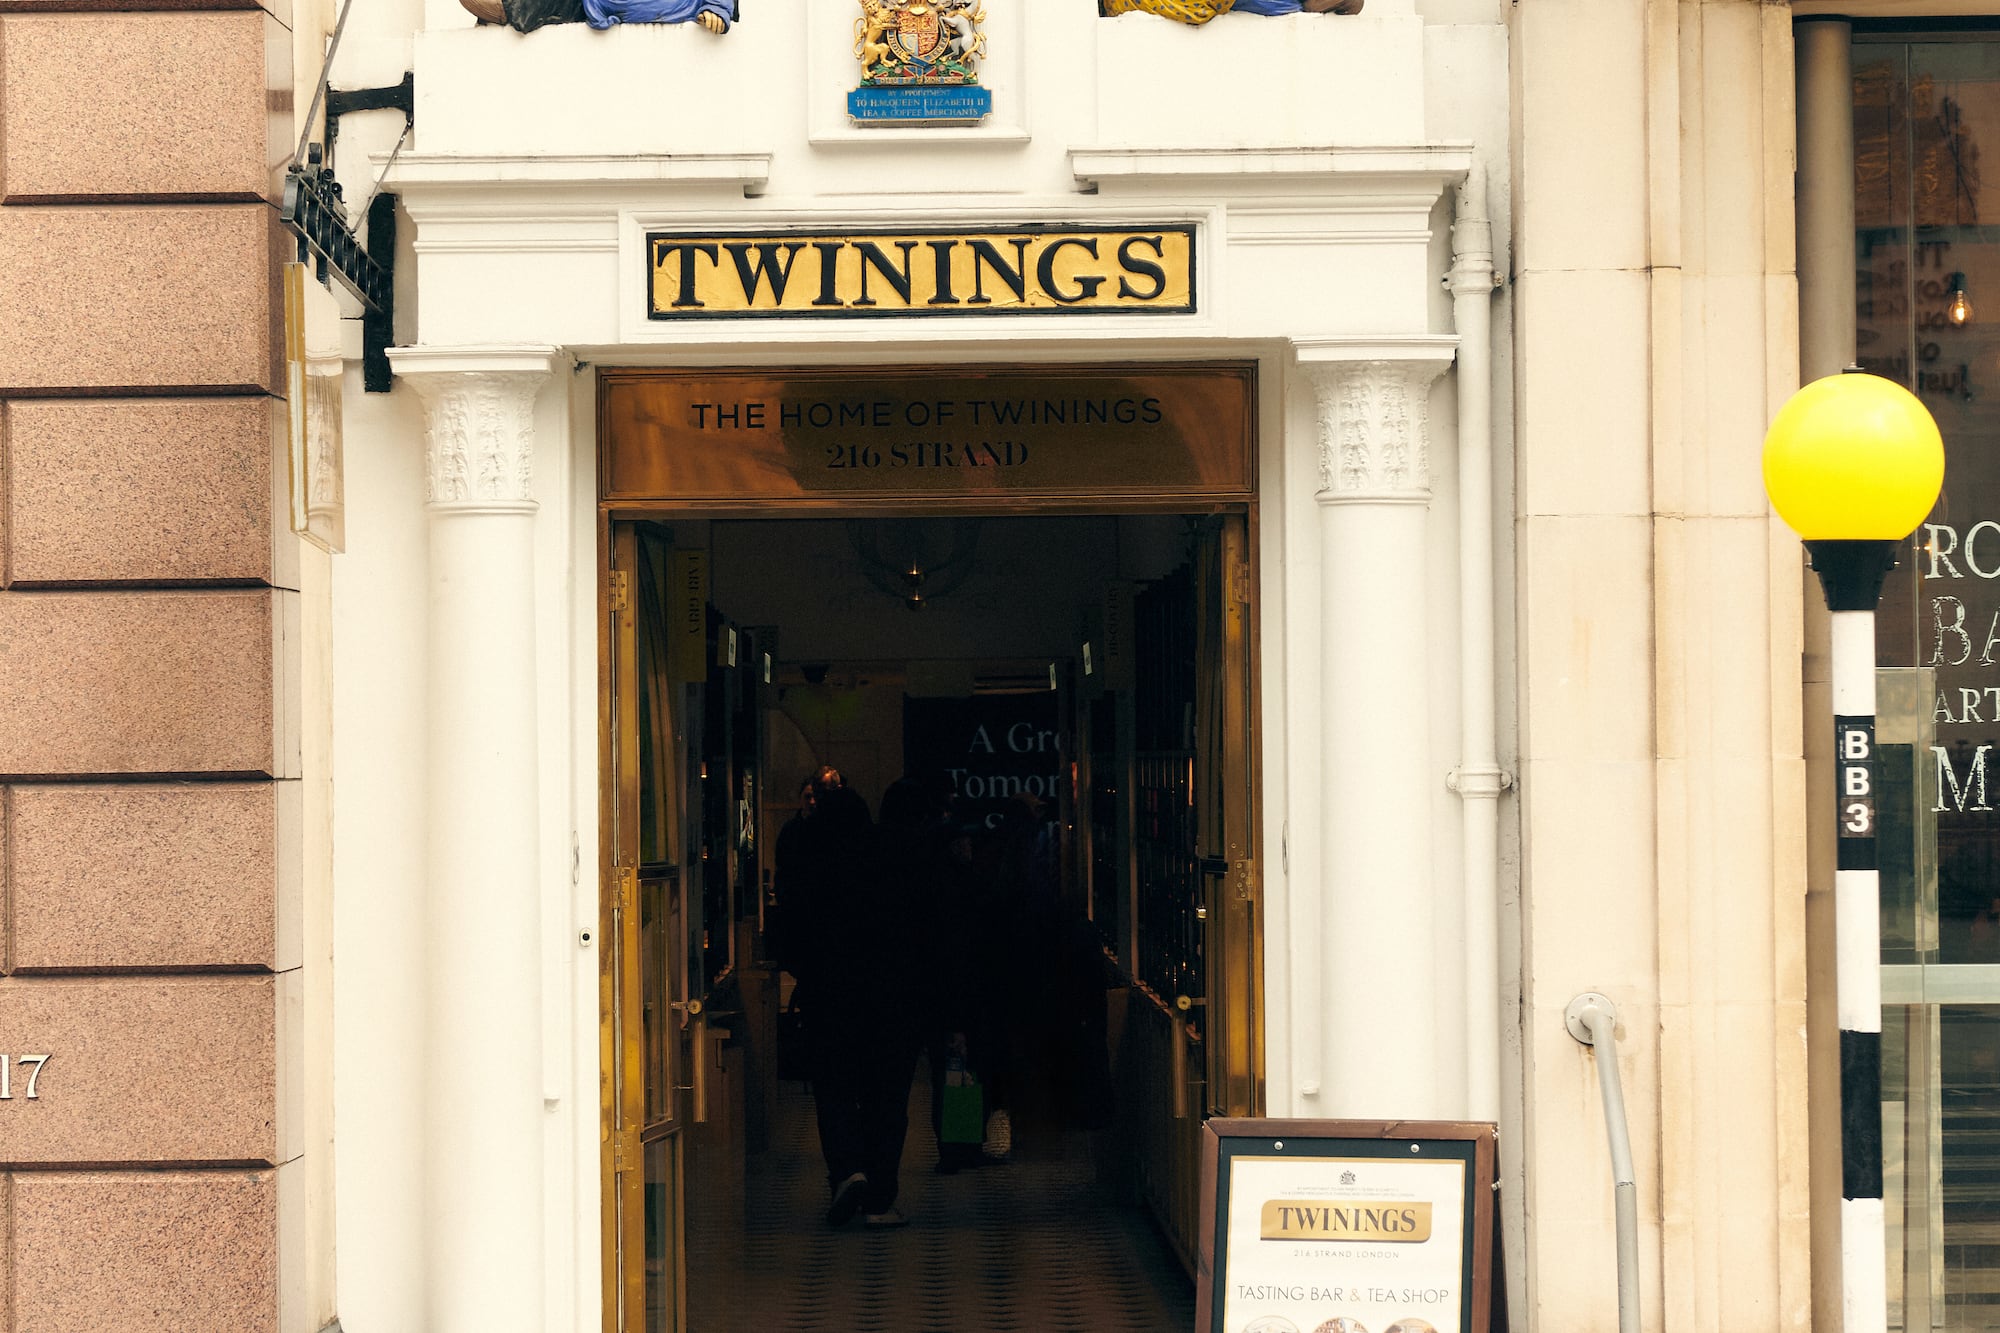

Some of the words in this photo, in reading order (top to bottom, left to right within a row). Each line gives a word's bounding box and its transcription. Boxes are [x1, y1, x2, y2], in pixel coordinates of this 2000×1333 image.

[856, 98, 867, 107] TO
[924, 98, 973, 107] ELIZABETH
[977, 97, 984, 106] II
[890, 109, 922, 117] COFFEE
[924, 108, 978, 117] MERCHANTS
[656, 235, 1167, 307] TWININGS
[691, 403, 765, 429] THE
[780, 402, 892, 428] HOME
[905, 401, 954, 427] OF
[966, 398, 1162, 426] TWININGS
[826, 444, 881, 469] 216
[891, 441, 1028, 468] STRAND
[968, 723, 996, 753] A
[1278, 1206, 1416, 1233] TWININGS
[1294, 1249, 1311, 1257] 216
[1315, 1250, 1352, 1258] STRAND
[1356, 1250, 1399, 1259] LONDON
[1237, 1285, 1305, 1301] TASTING
[1310, 1286, 1343, 1301] BAR
[1350, 1288, 1361, 1302] &
[1368, 1288, 1397, 1303] TEA
[1402, 1288, 1449, 1304] SHOP
